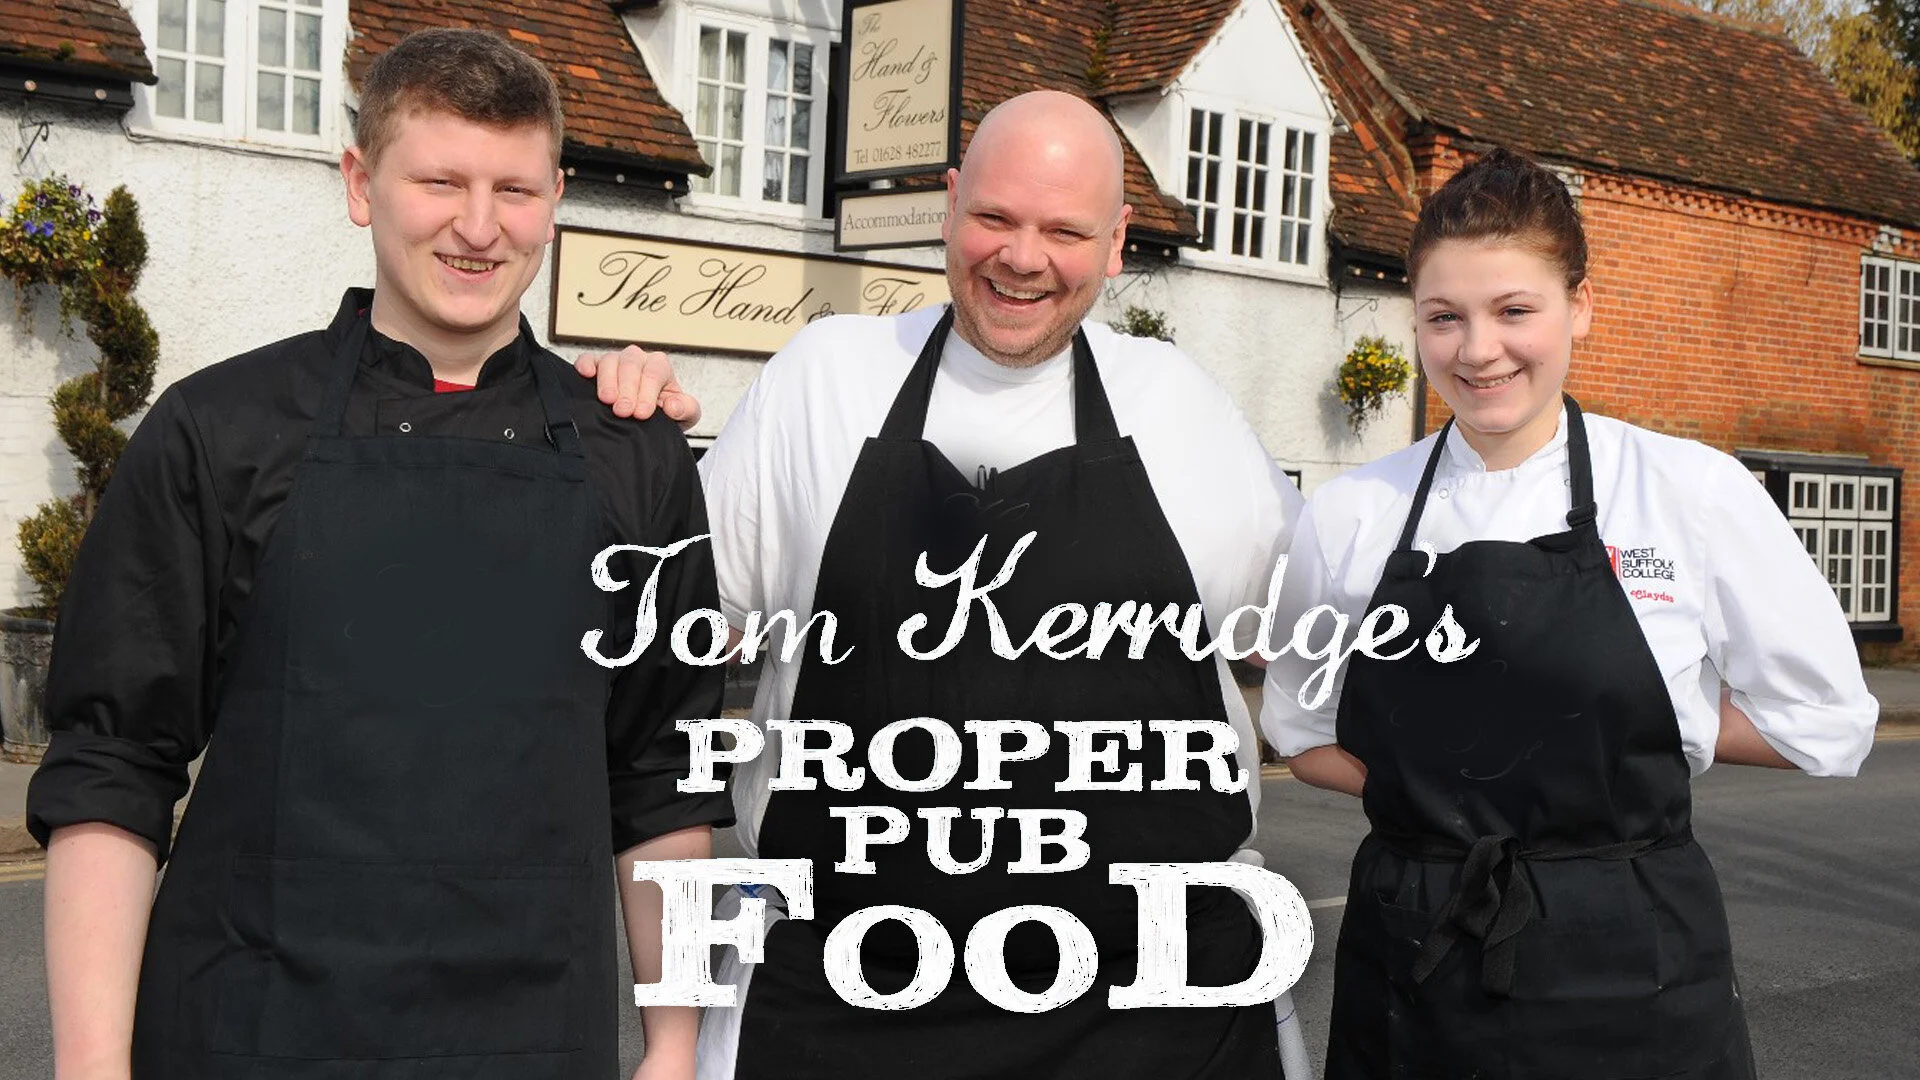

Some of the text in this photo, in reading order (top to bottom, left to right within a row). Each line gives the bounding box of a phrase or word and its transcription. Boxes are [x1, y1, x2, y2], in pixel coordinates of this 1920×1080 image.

[858, 13, 881, 36] The
[853, 38, 938, 84] Hand &
[863, 88, 945, 131] Flowers
[855, 141, 941, 164] Tel 01628 482277
[844, 207, 947, 230] Accommodation
[577, 250, 672, 312] The
[679, 258, 814, 325] Hand
[1621, 547, 1656, 558] WEST
[1621, 558, 1674, 570] SUFFOLK
[1622, 569, 1675, 581] COLLEGE
